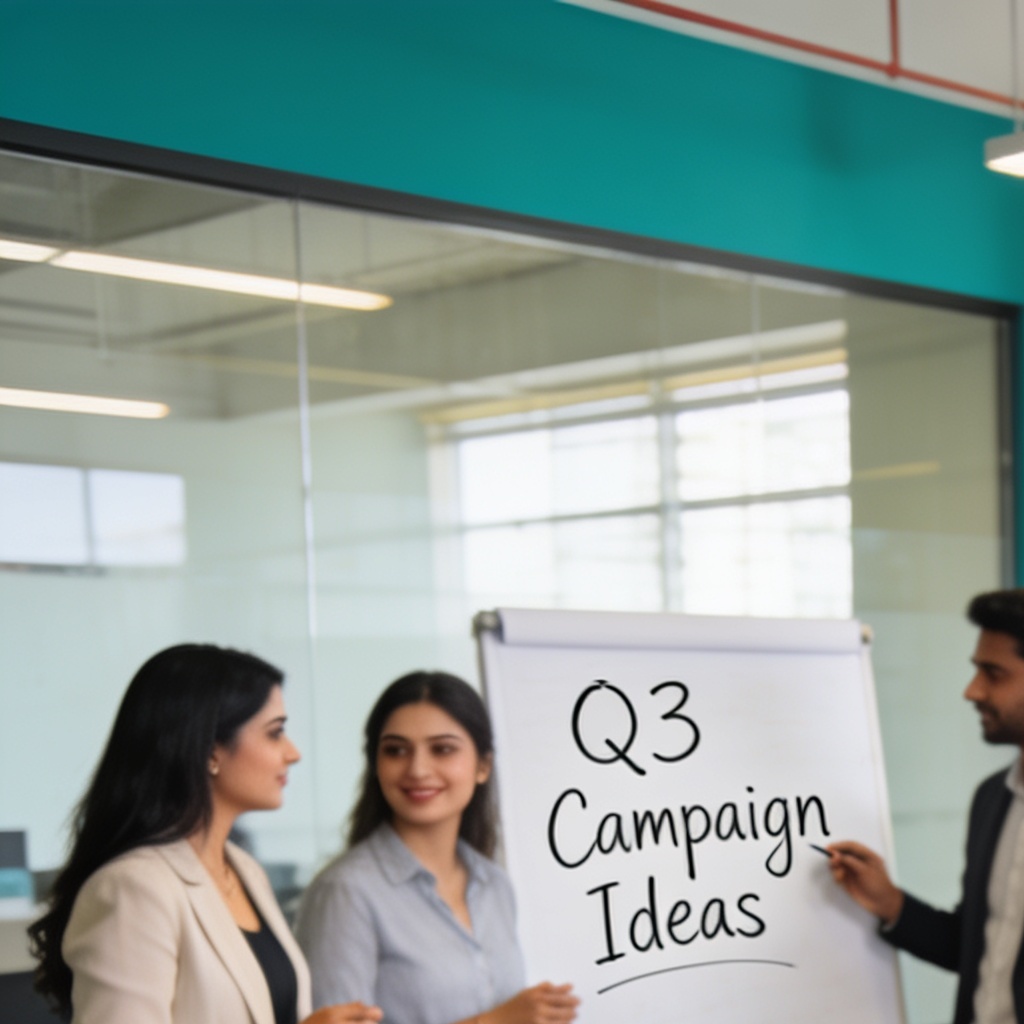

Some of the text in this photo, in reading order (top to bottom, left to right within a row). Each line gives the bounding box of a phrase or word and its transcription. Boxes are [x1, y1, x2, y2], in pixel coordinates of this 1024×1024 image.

[571, 679, 701, 776] Q3
[547, 786, 831, 880] Campaign
[587, 876, 766, 965] Ideas
